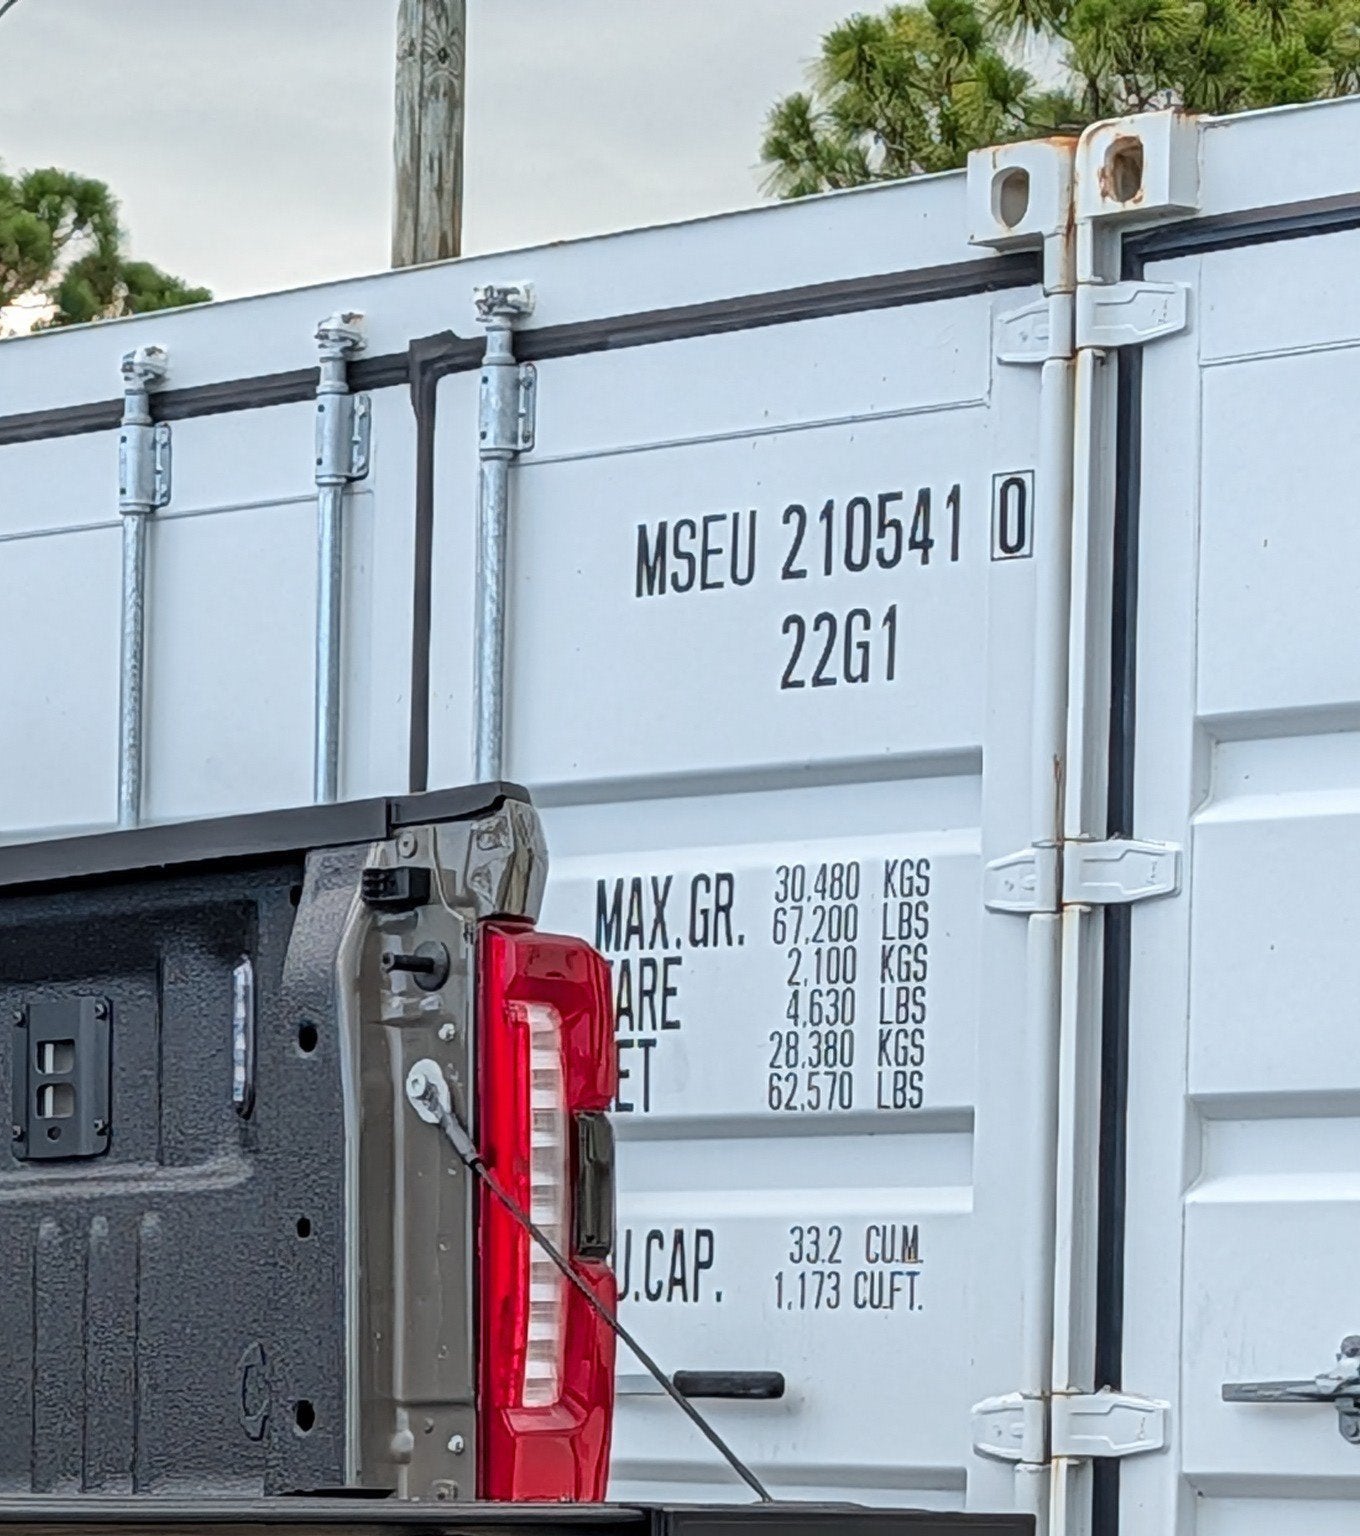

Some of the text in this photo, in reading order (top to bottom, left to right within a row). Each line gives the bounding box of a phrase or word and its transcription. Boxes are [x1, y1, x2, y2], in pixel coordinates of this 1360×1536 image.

[635, 474, 1029, 598] MSEU 210541 0
[779, 603, 899, 690] 22G1
[883, 858, 931, 899] KGS
[881, 901, 929, 941] LBS
[608, 956, 682, 1032] ARE
[880, 943, 928, 983] KGS
[879, 986, 927, 1025] LBS
[611, 1038, 657, 1113] ET
[877, 1028, 925, 1067] KGS
[876, 1069, 924, 1109] LBS
[616, 1228, 723, 1303] U.CAP.
[789, 1225, 842, 1263] 33.2
